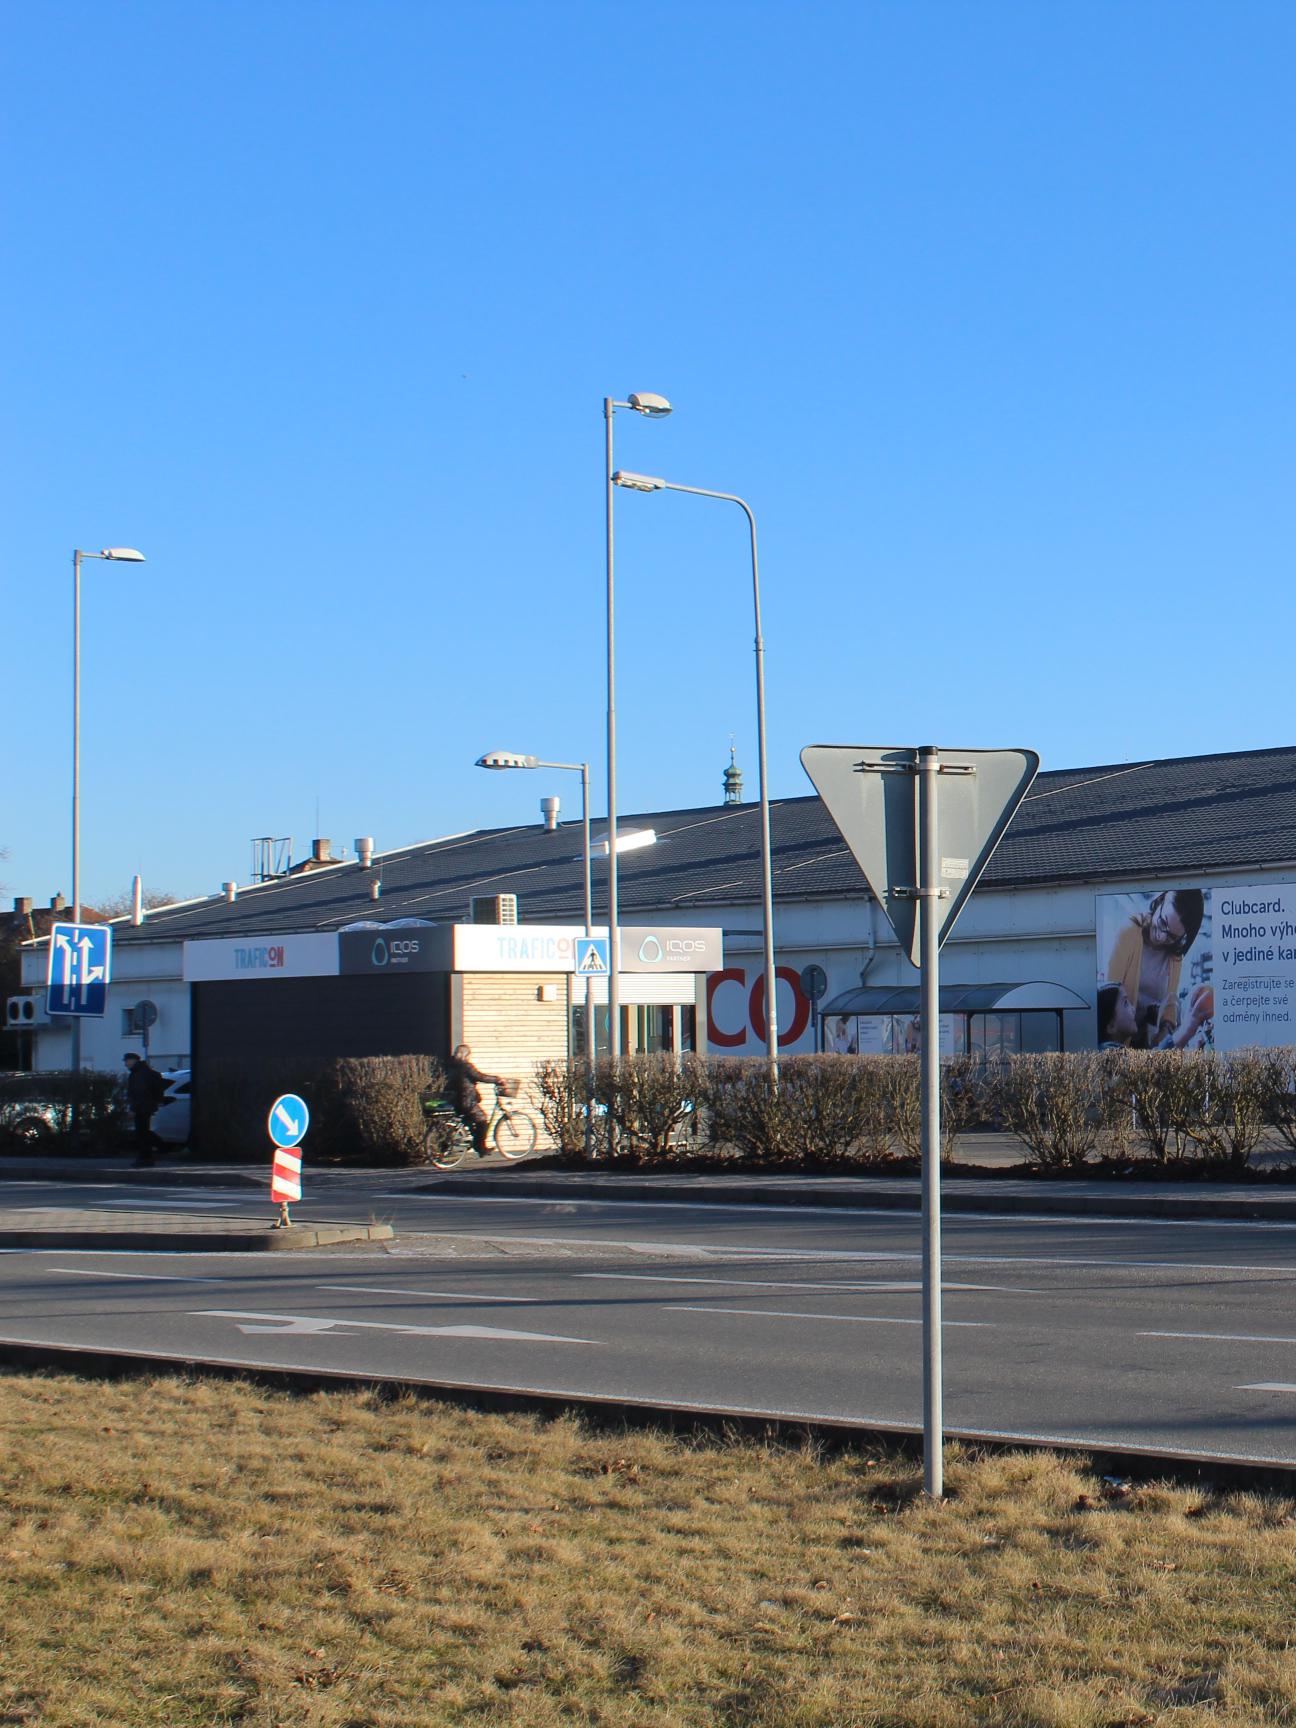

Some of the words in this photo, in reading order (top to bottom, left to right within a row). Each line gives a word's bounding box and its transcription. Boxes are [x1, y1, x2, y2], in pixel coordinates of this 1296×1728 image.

[1221, 898, 1285, 915] Clubcard.
[1222, 924, 1266, 939] Mnoho
[390, 940, 419, 953] IQOS
[666, 940, 705, 953] IQOS
[234, 946, 284, 969] TRAFICON
[1222, 951, 1229, 962] v
[1233, 946, 1274, 966] jediné
[1222, 978, 1282, 992] Zaregistrujte
[1284, 980, 1295, 989] se
[1222, 998, 1228, 1007] a
[1230, 995, 1270, 1008] čerpejte
[1272, 994, 1289, 1005] své
[1222, 1011, 1260, 1024] odměny
[1262, 1011, 1292, 1022] ihned.
